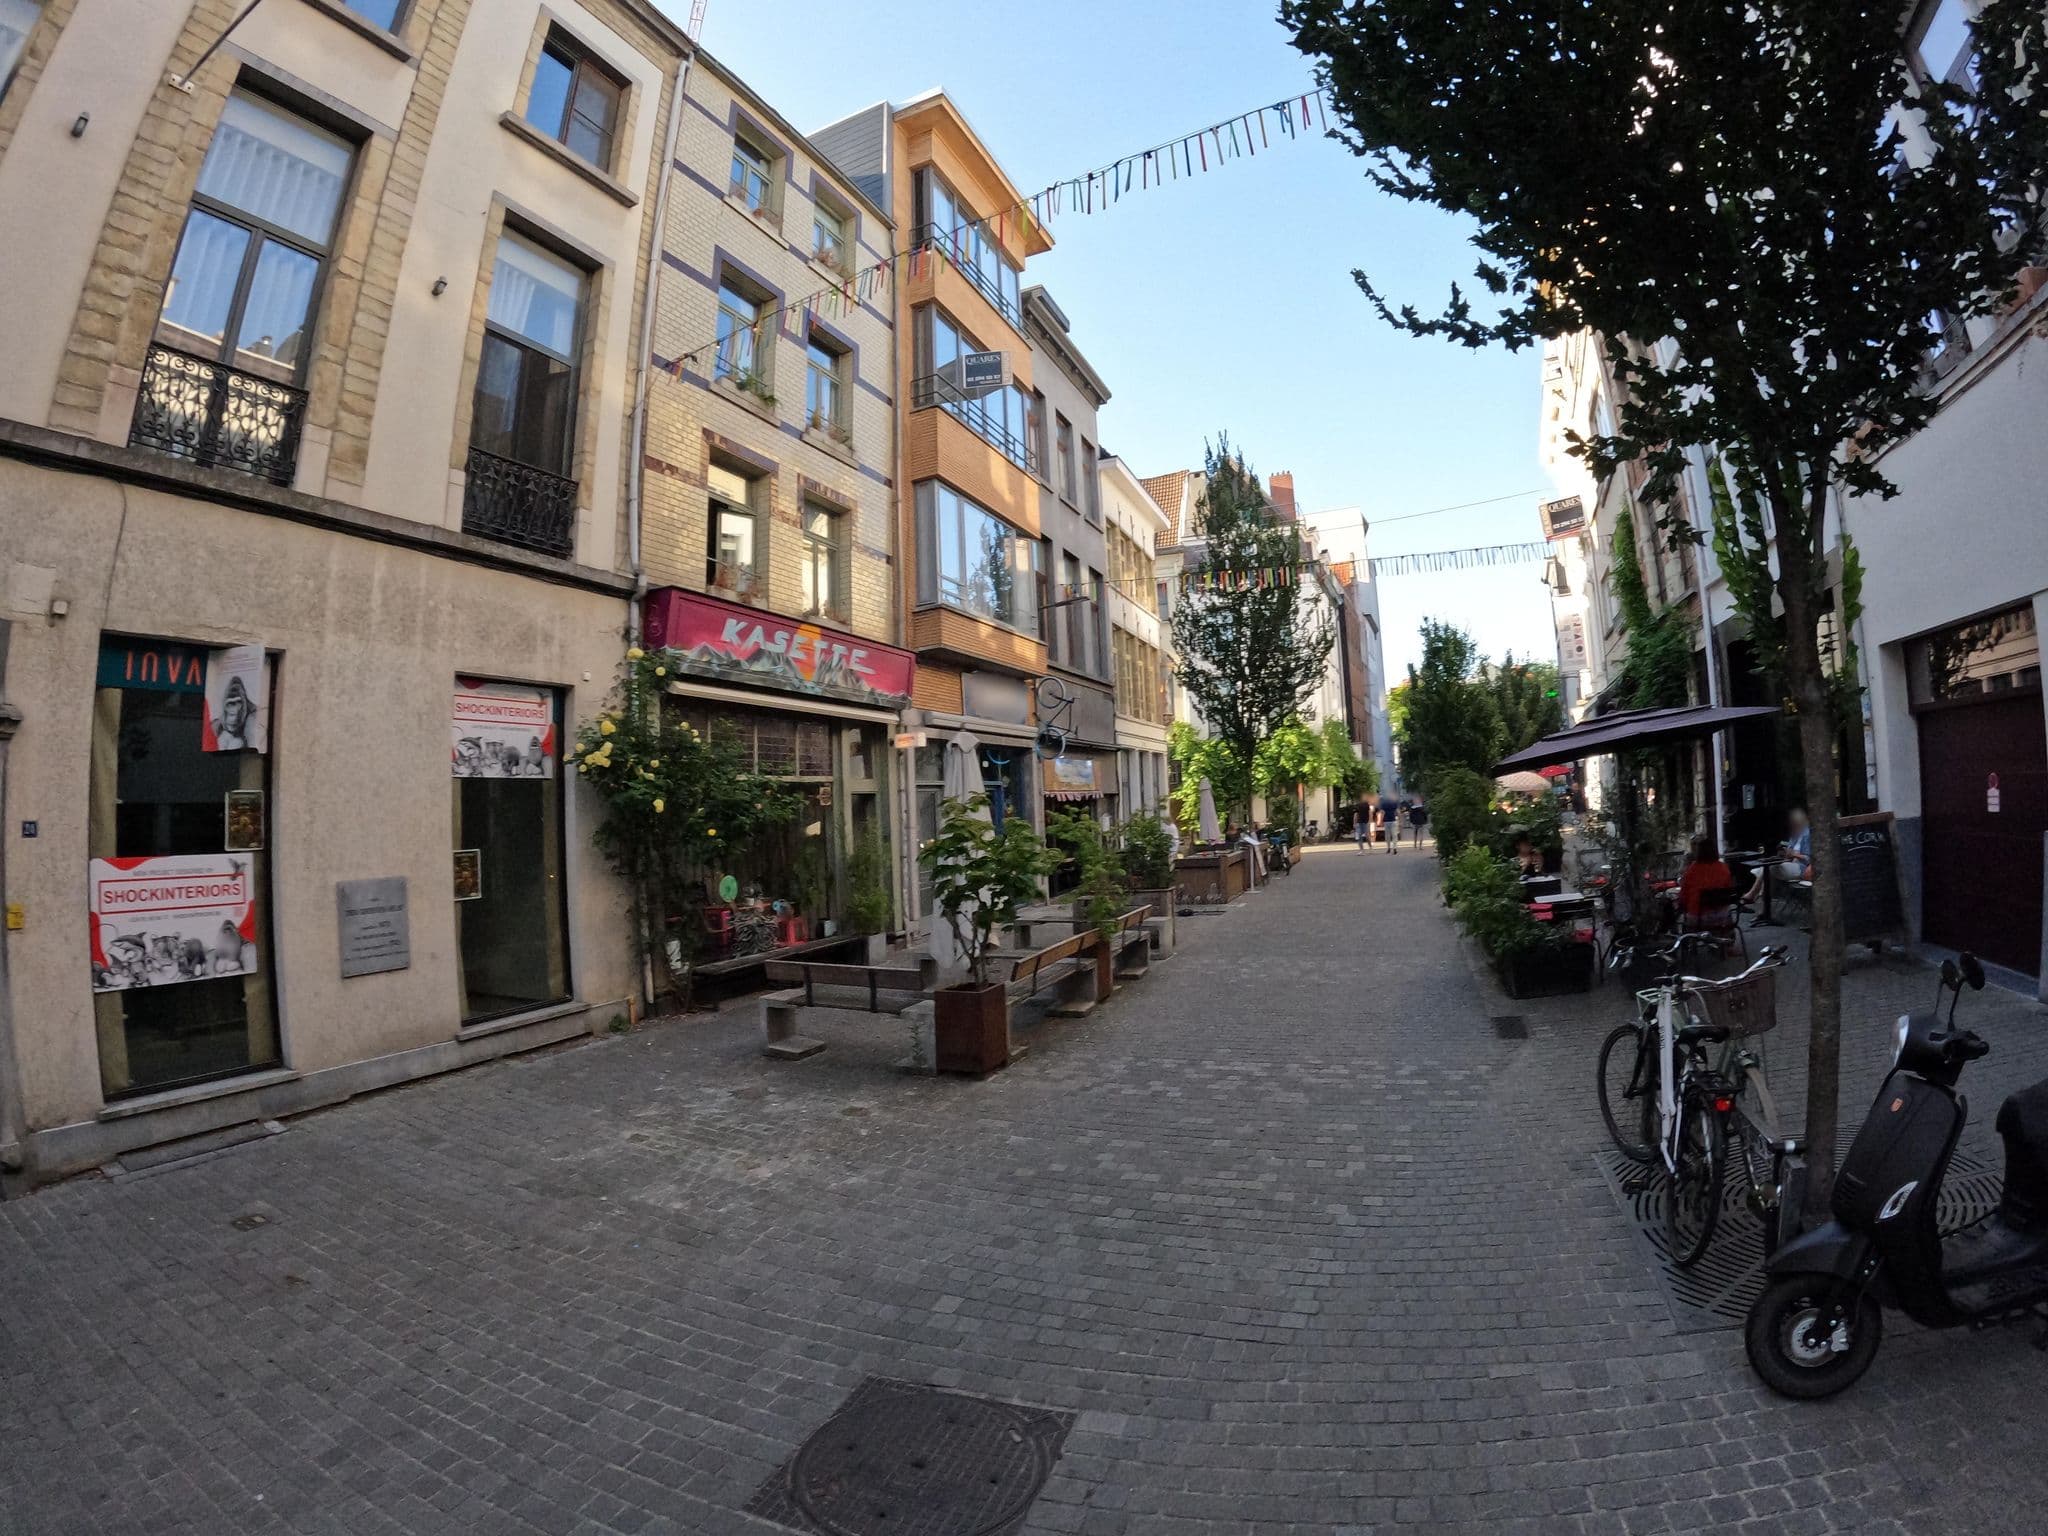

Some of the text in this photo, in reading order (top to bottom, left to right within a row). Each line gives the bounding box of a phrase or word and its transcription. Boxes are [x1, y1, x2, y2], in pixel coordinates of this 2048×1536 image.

[721, 617, 877, 676] KASETTE
[455, 702, 545, 719] SHOCKINTERIORS
[103, 883, 242, 904] SHOCKINTERIORS
